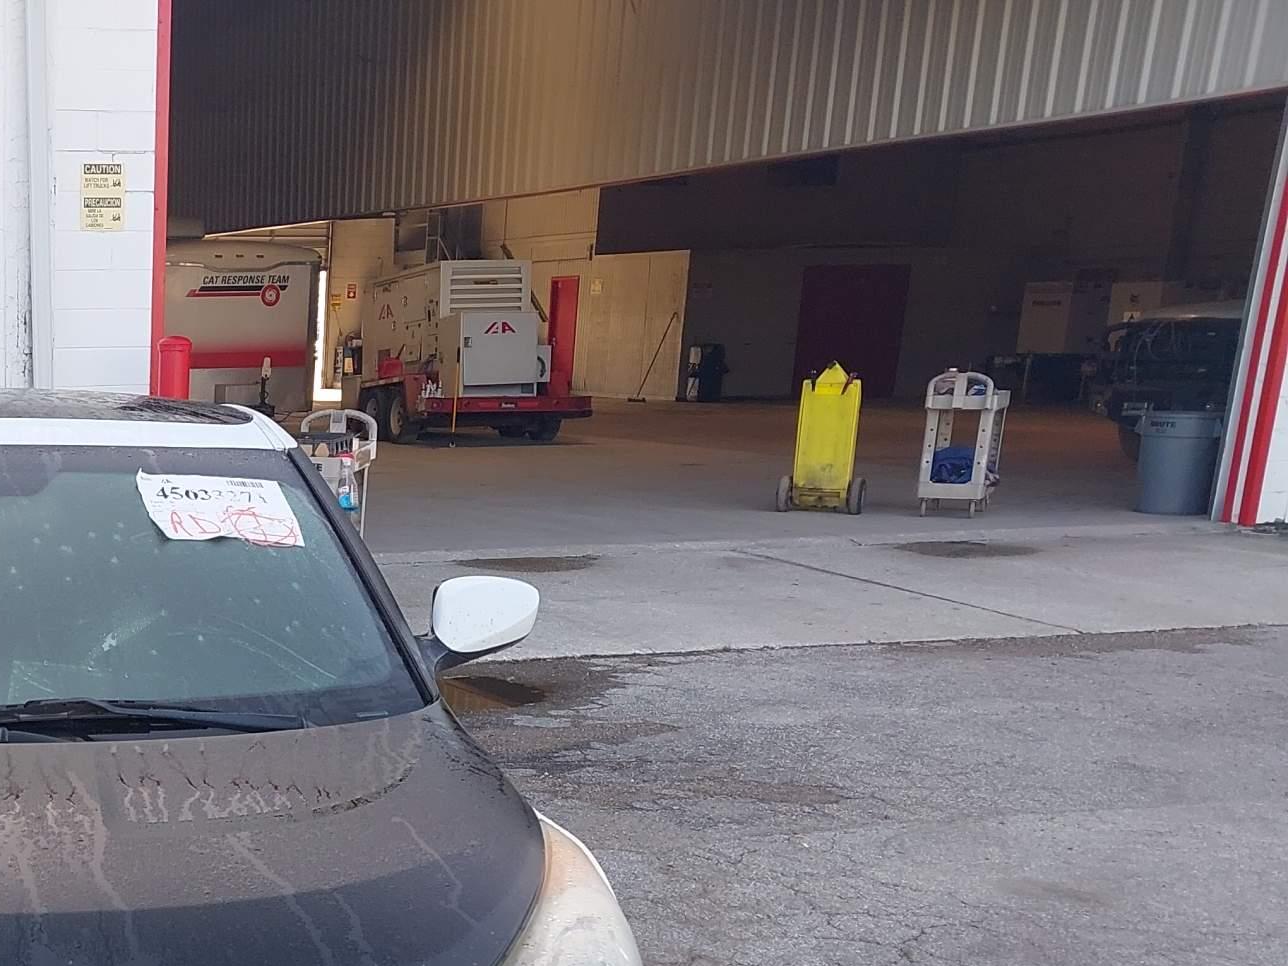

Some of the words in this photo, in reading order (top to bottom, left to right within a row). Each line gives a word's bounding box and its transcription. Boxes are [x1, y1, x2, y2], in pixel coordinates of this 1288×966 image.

[84, 164, 121, 174] CAUTION
[202, 275, 221, 285] CAT
[221, 275, 266, 284] RESPONSE
[268, 274, 290, 284] TEAM
